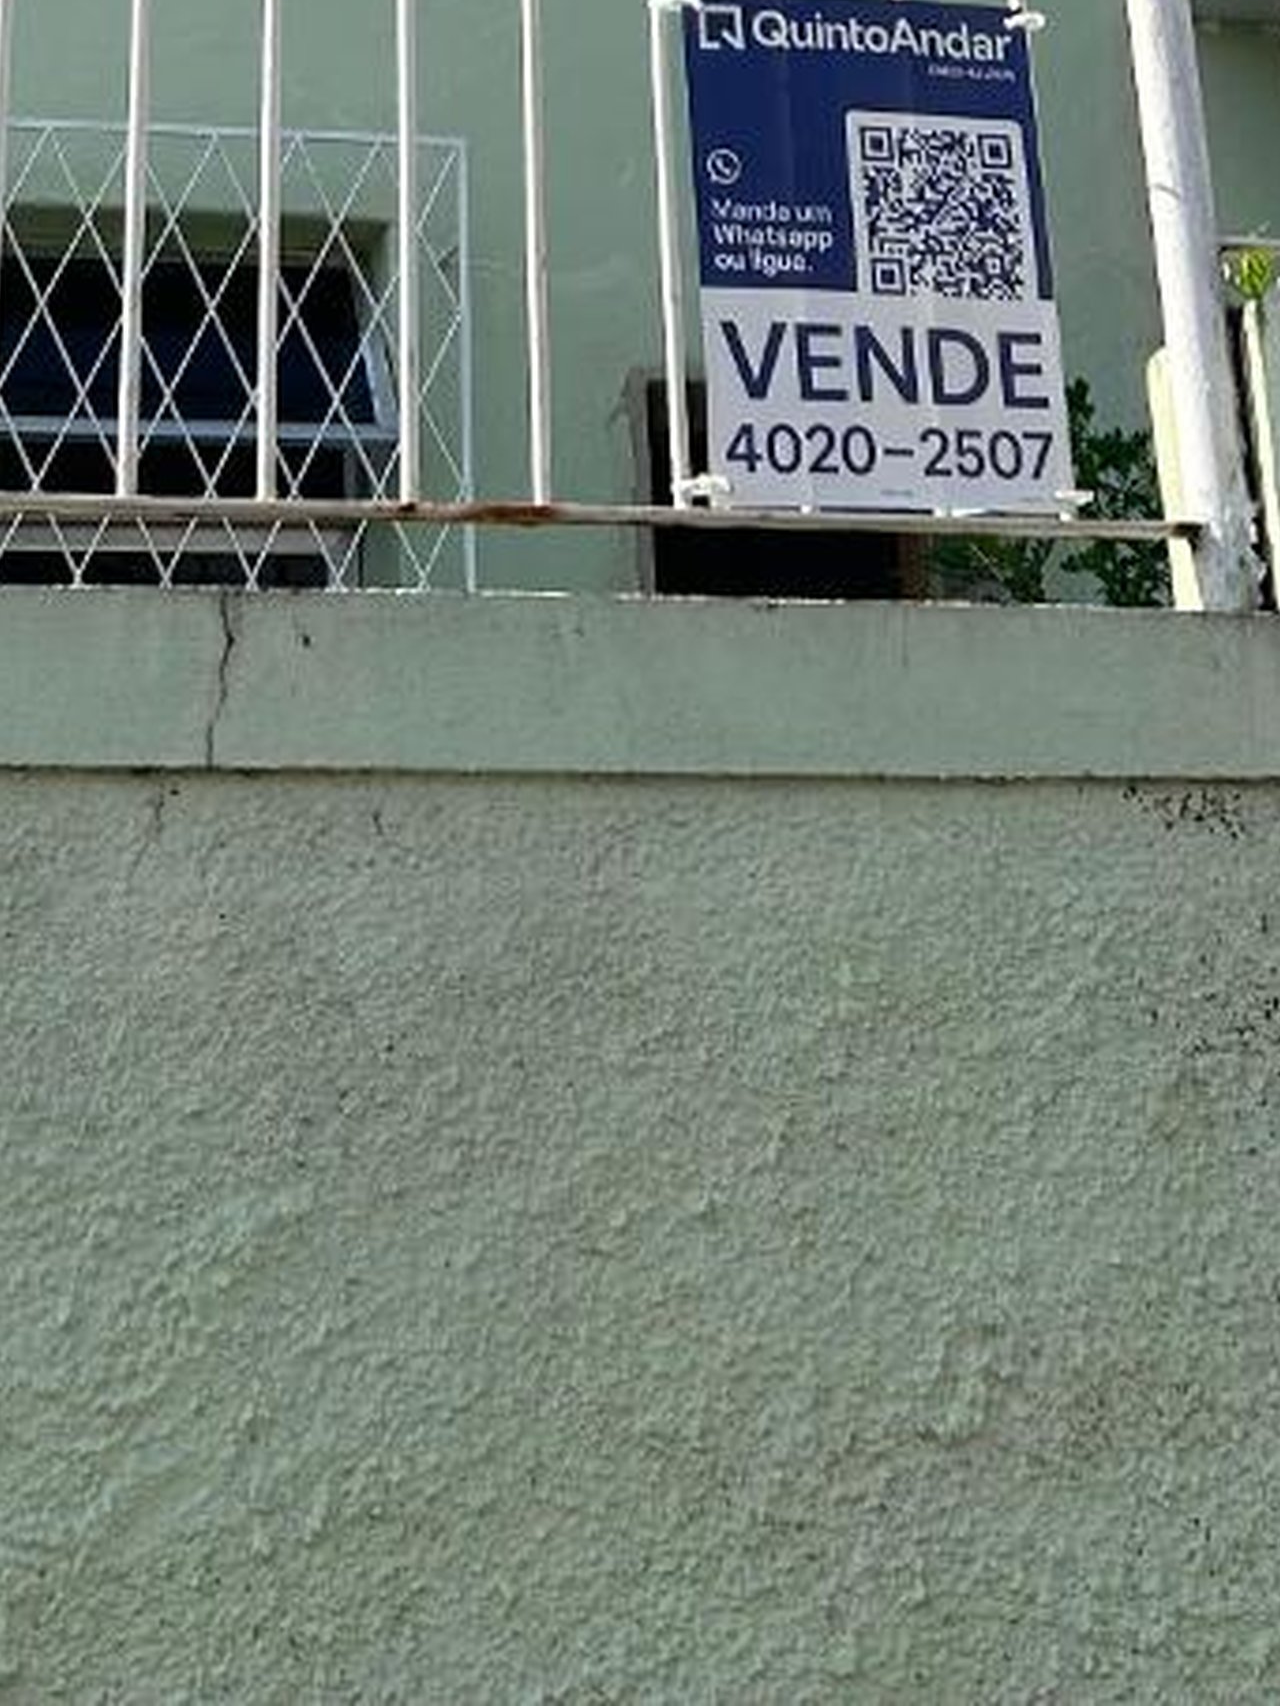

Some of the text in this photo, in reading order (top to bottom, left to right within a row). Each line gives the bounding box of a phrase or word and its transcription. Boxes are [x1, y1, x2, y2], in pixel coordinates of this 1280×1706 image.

[751, 9, 1012, 62] QuintoAndar
[714, 252, 745, 271] ou
[719, 319, 1051, 409] VENDE
[724, 423, 1054, 480] 4020-2507
